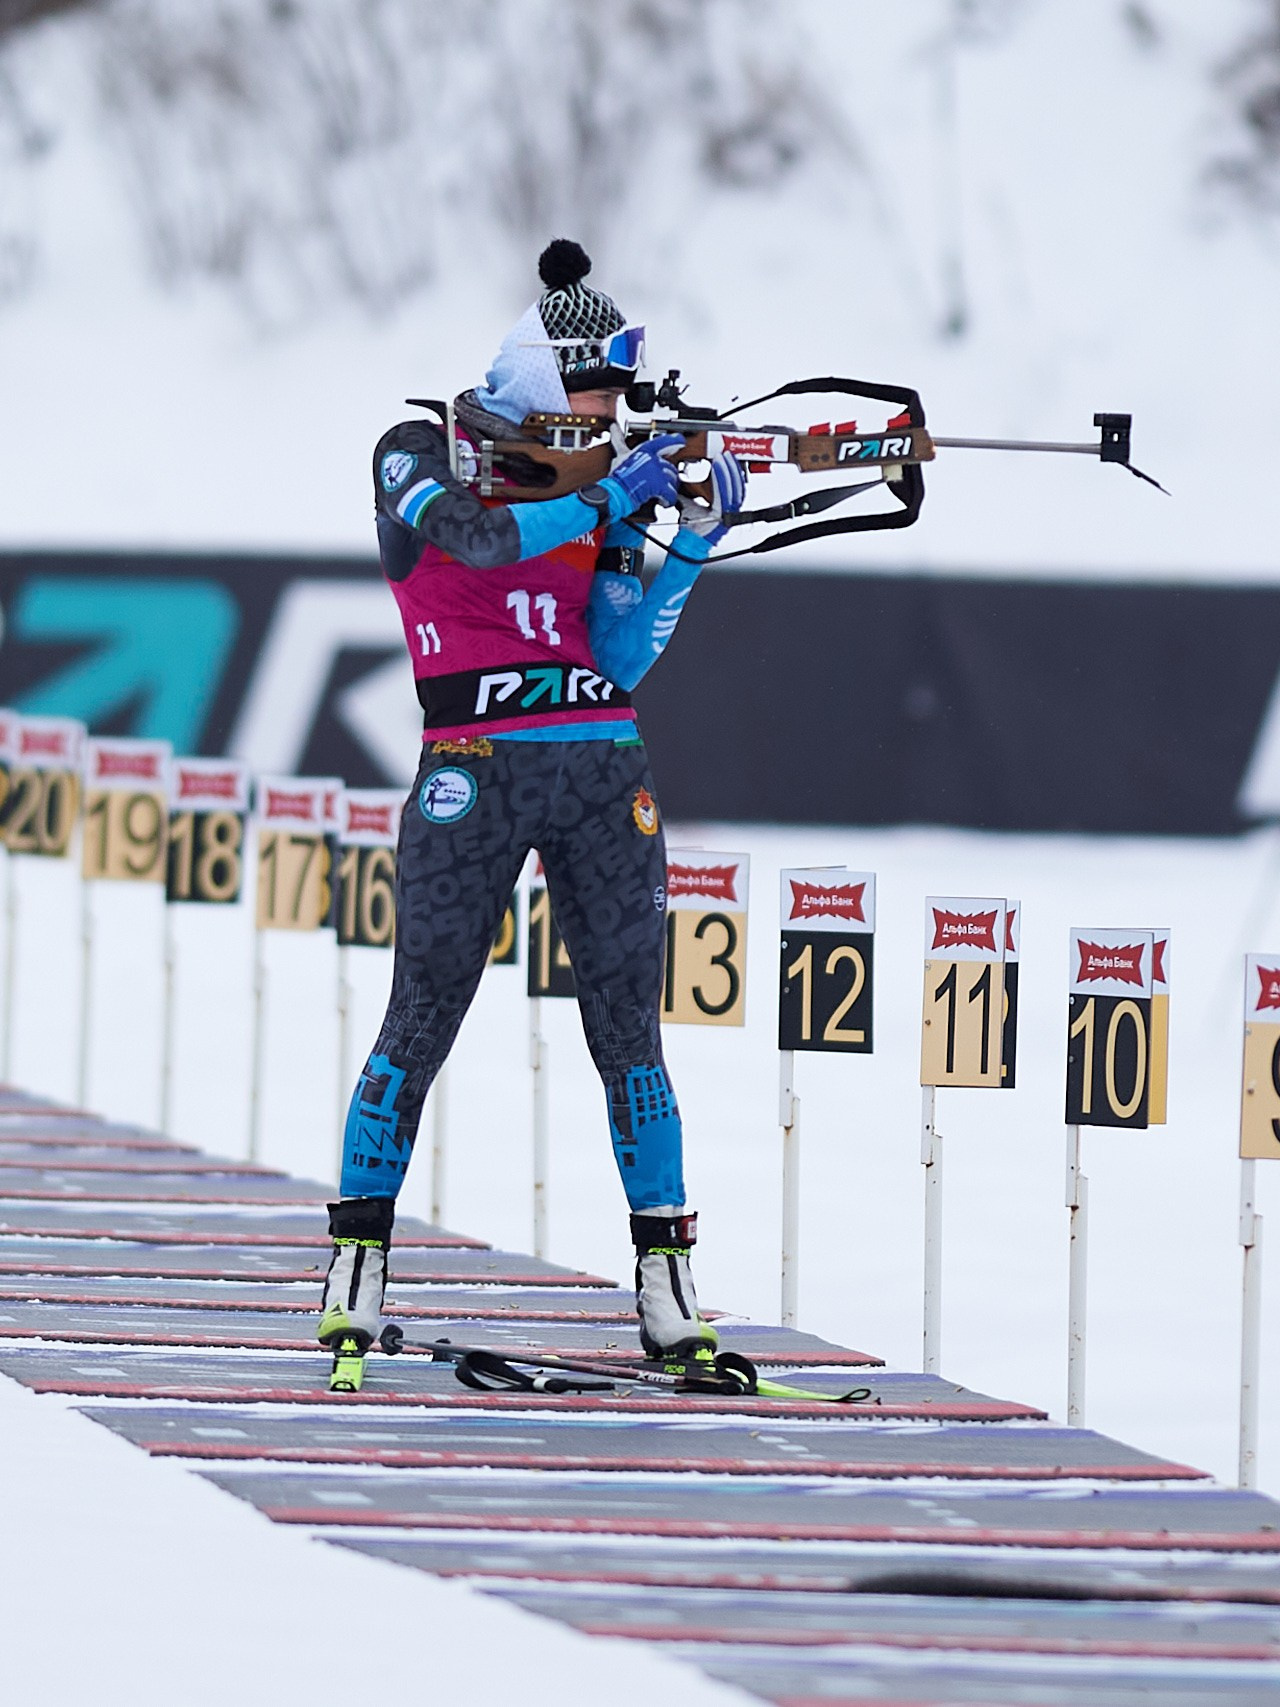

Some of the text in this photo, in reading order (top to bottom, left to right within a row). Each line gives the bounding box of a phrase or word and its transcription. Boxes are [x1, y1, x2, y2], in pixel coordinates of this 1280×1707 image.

[566, 357, 600, 374] PARI
[838, 436, 912, 461] PARI
[417, 622, 442, 656] 11
[507, 589, 561, 645] 11
[475, 667, 614, 715] PARI
[5, 768, 71, 850] 20
[88, 792, 163, 877] 19
[168, 811, 241, 900] 18
[260, 834, 319, 922] 17
[338, 847, 395, 944] 16
[530, 888, 572, 989] 1
[802, 894, 854, 909] Альфа Банк
[942, 922, 987, 938] Альфа Банк
[665, 911, 740, 1016] 13
[788, 944, 866, 1043] 12
[1087, 955, 1134, 971] Альфа Банк
[934, 963, 991, 1075] 11
[1071, 997, 1147, 1119] 10
